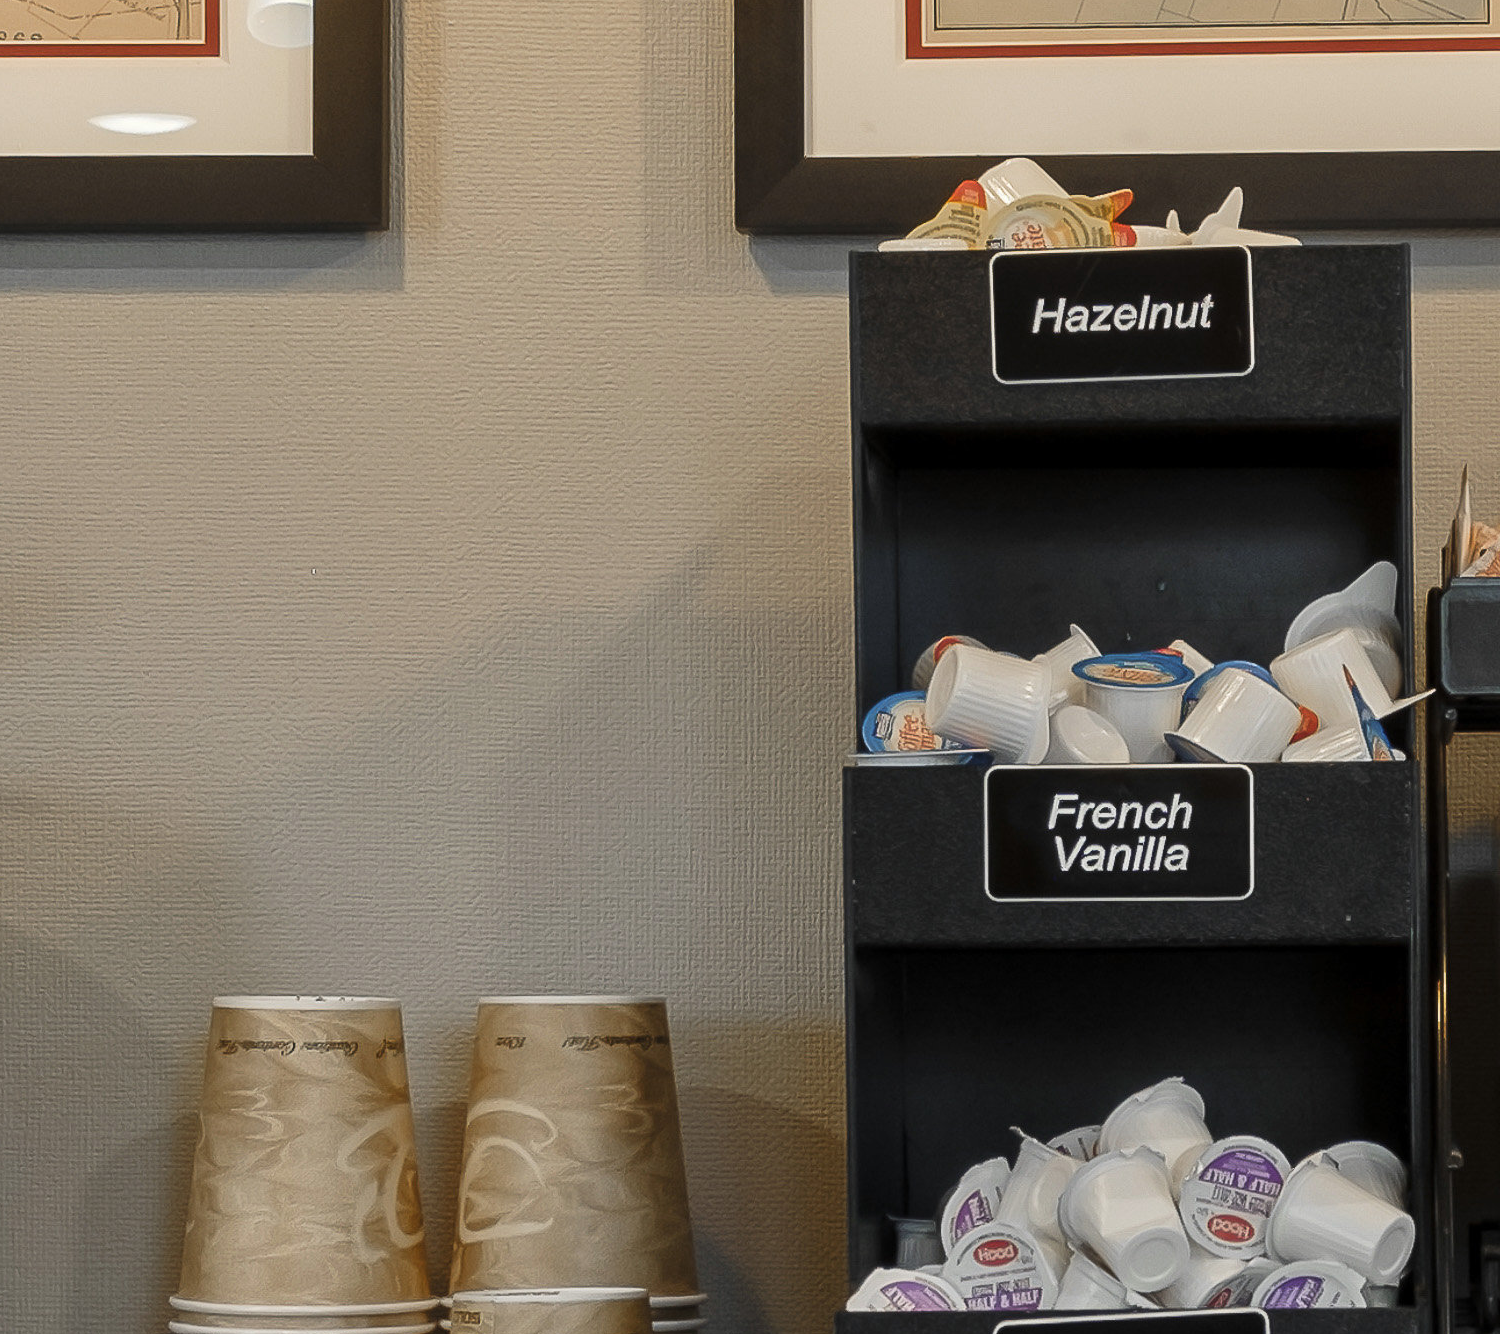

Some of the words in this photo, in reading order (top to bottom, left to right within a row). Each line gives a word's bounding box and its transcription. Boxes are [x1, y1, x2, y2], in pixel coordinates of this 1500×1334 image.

[1031, 293, 1214, 334] Hazelnut
[1047, 793, 1193, 831] French
[1053, 835, 1190, 873] Vanilla
[976, 1243, 1018, 1264] Hood
